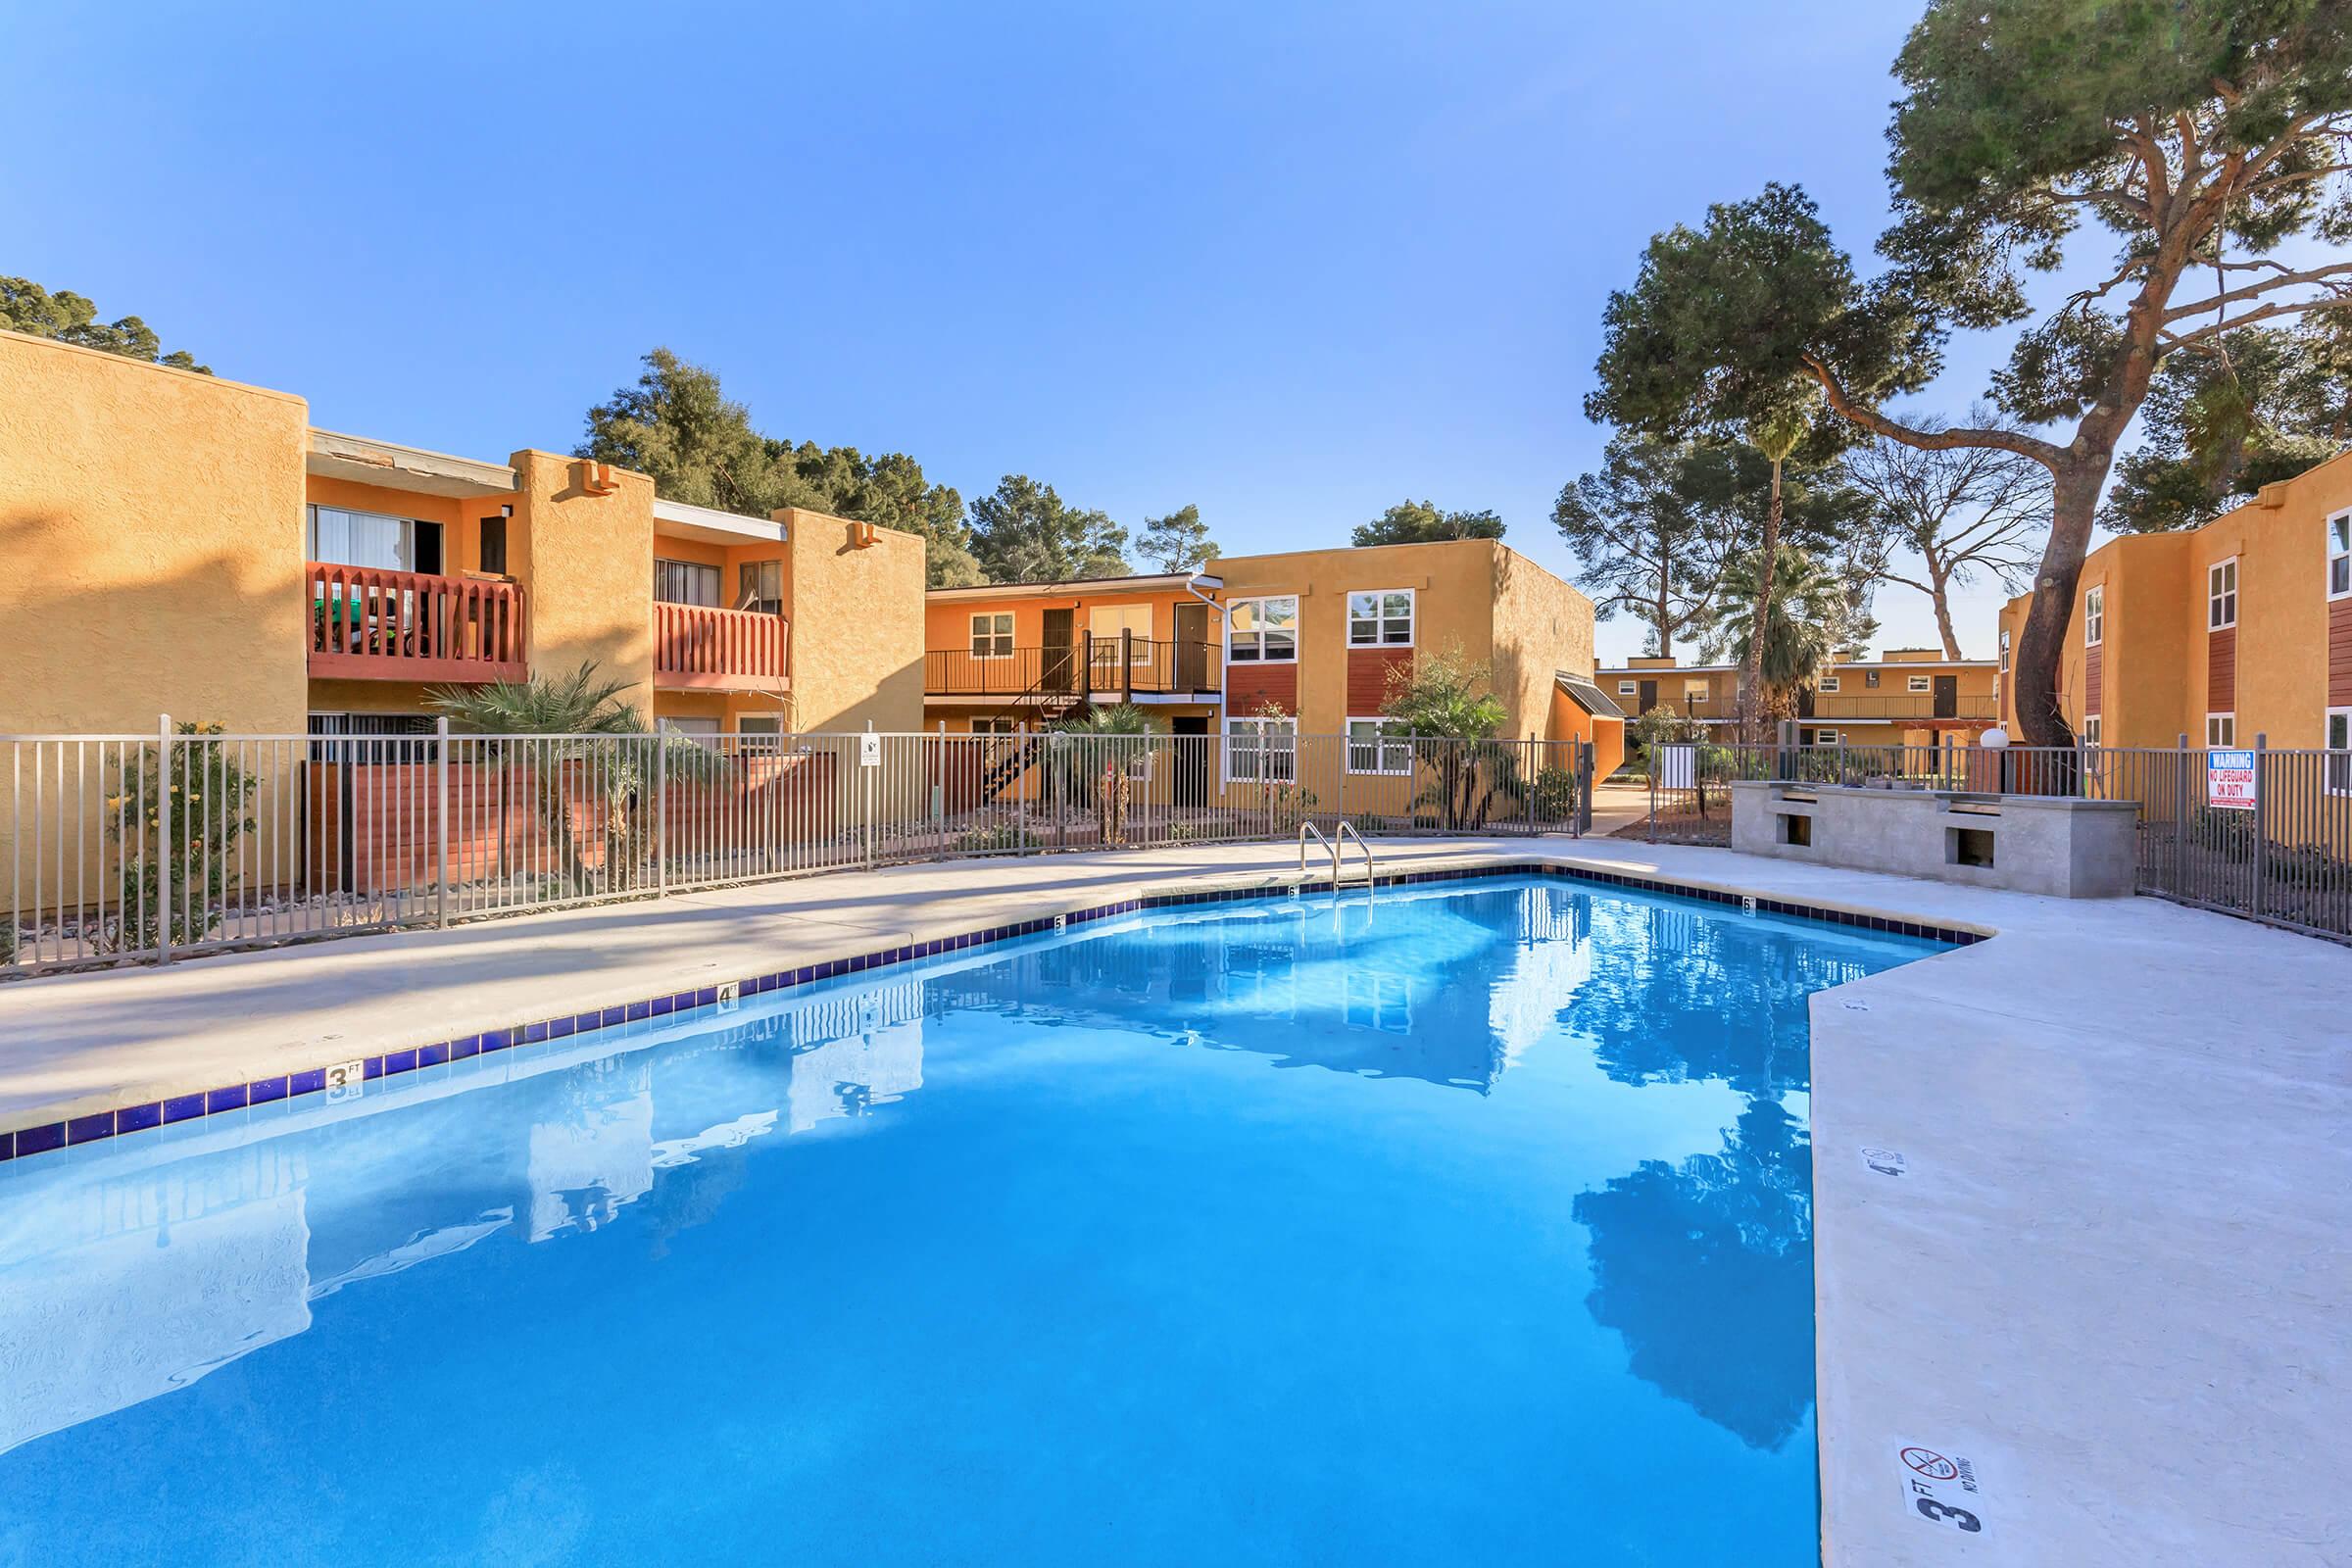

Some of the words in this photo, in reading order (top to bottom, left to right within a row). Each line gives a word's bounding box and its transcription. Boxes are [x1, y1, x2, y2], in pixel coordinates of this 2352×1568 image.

[1869, 671, 1877, 681] L
[2213, 753, 2251, 769] WARNING
[2210, 769, 2218, 782] NO
[2220, 769, 2252, 783] LIFEGUARD
[2218, 783, 2226, 796] ON
[2228, 783, 2243, 797] DUTY
[1289, 886, 1295, 897] 6
[1743, 898, 1750, 909] 6
[719, 986, 732, 1004] 4
[329, 1068, 346, 1088] 3
[349, 1063, 360, 1073] FT
[1869, 1164, 1905, 1176] 4
[1956, 1456, 1976, 1482] DIVING
[1911, 1478, 1934, 1497] FT
[1962, 1481, 1979, 1494] NO
[1917, 1497, 1982, 1532] 3
